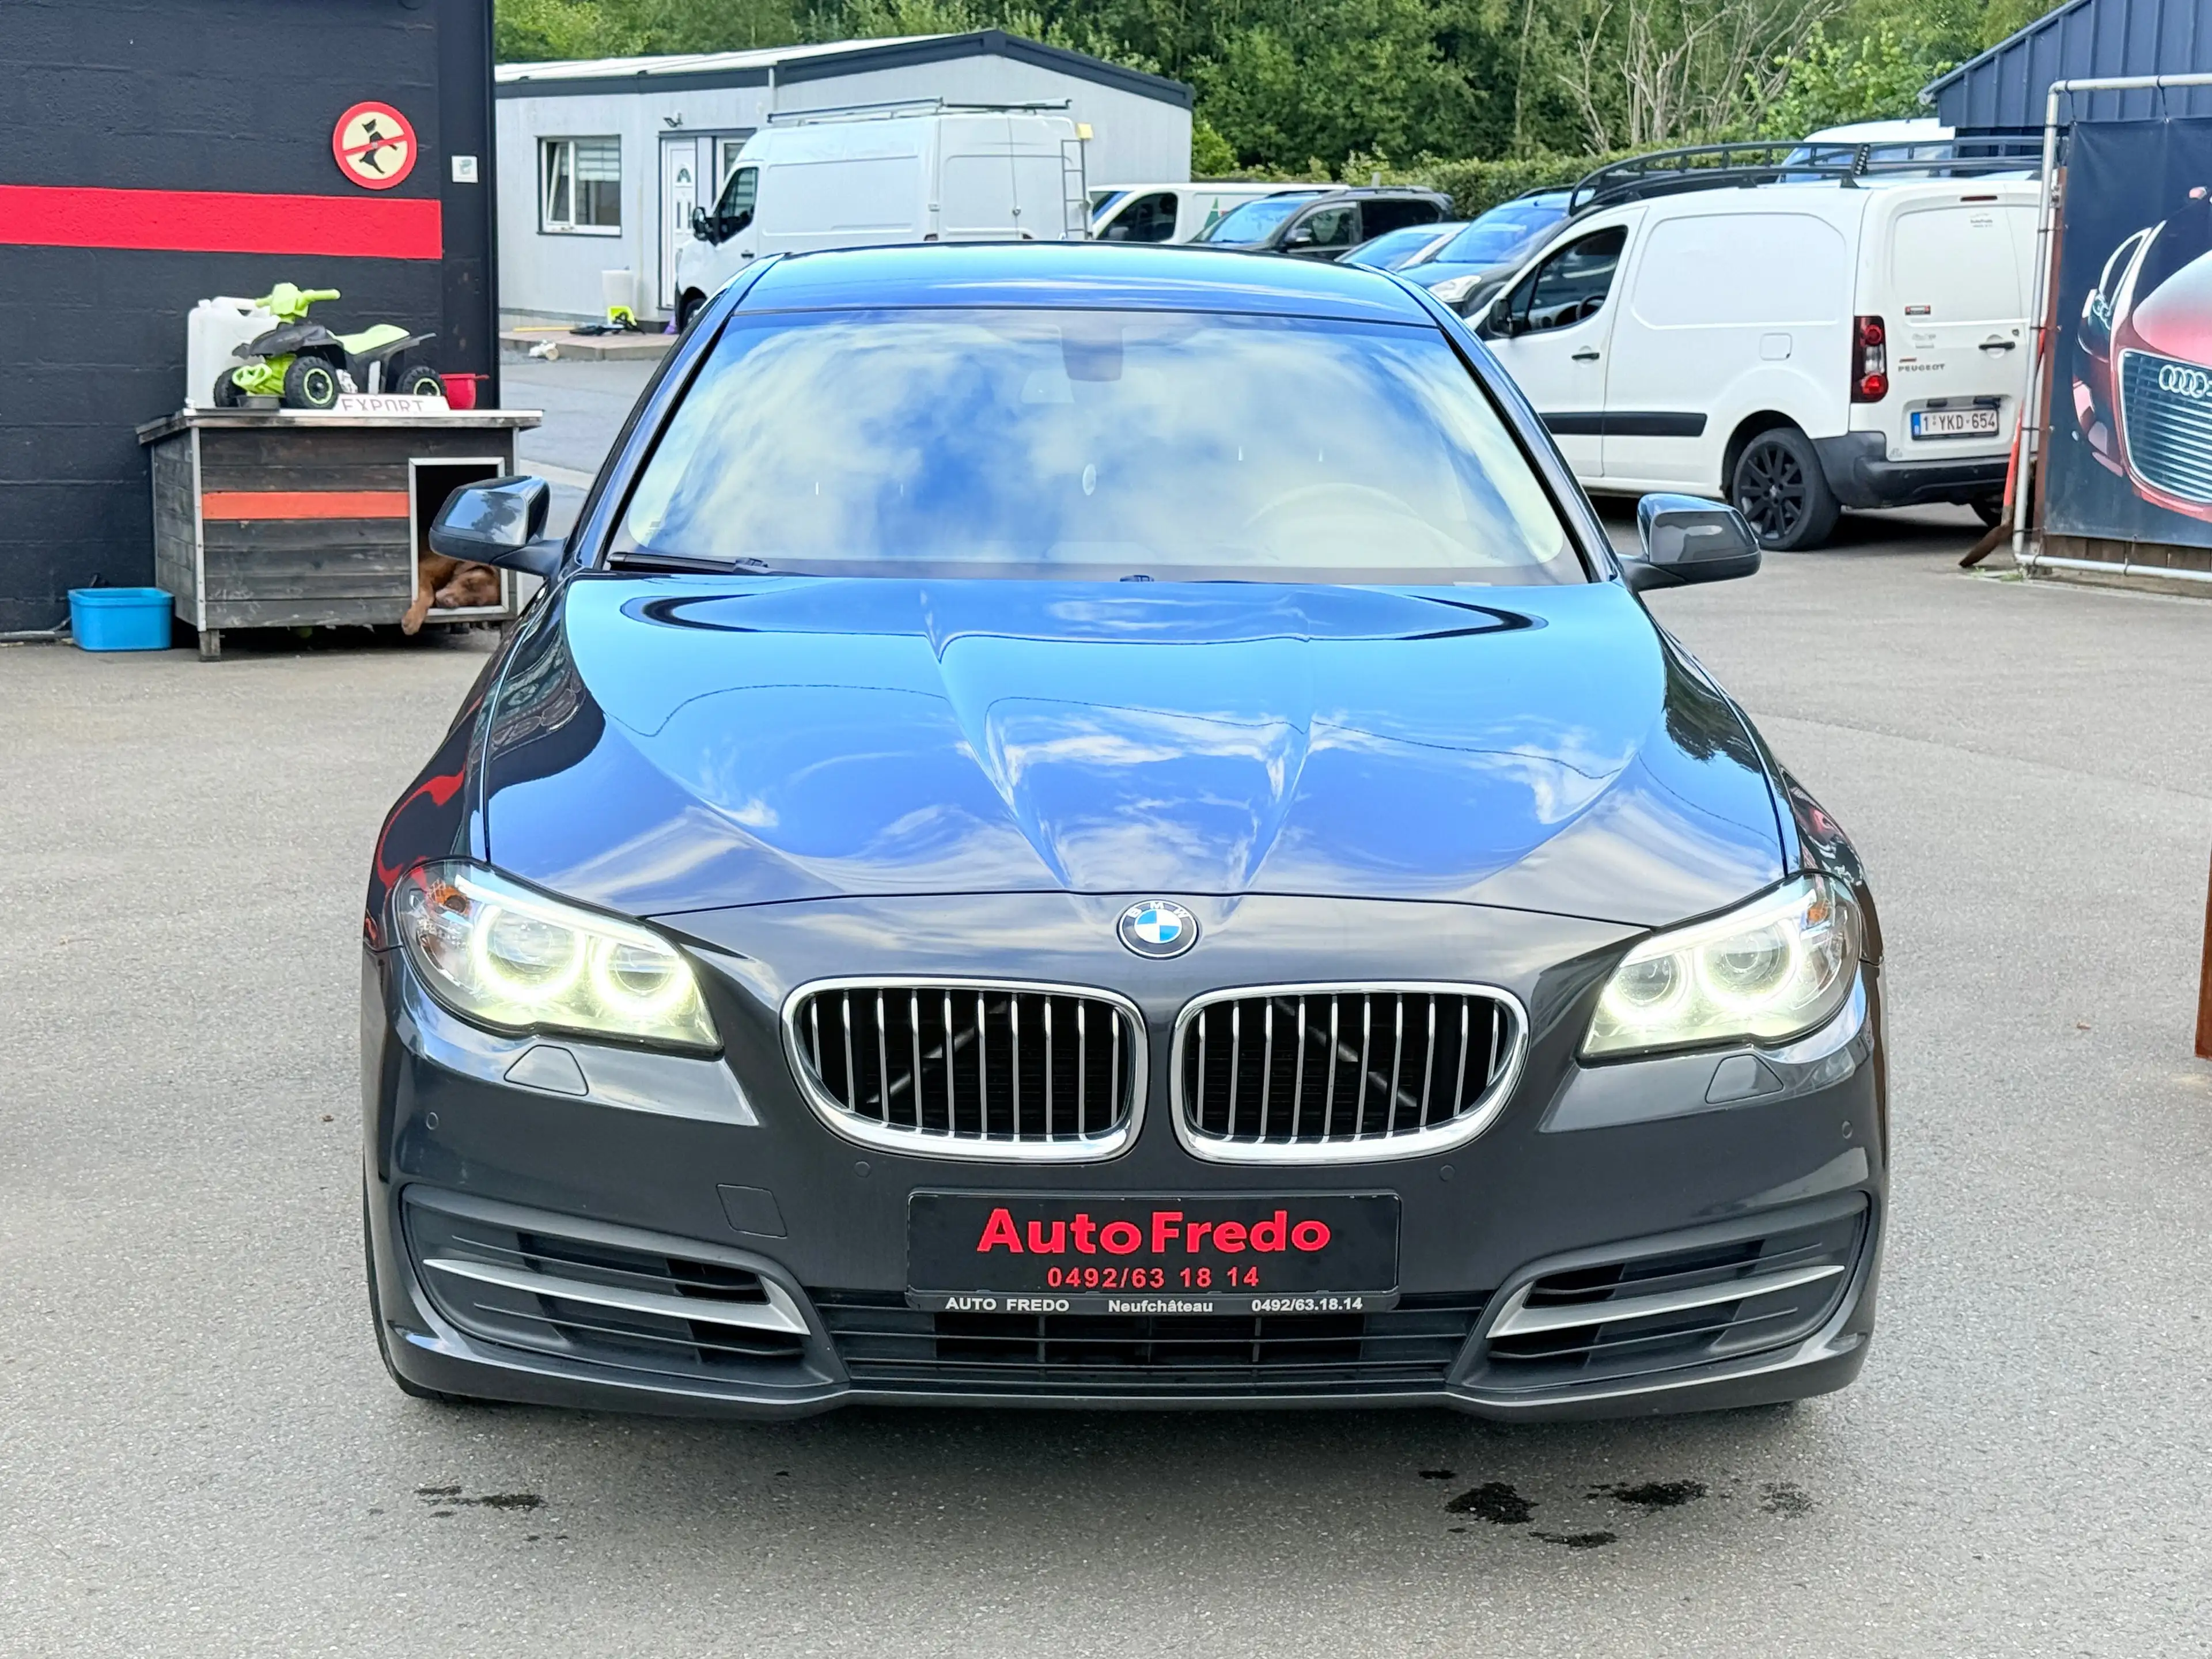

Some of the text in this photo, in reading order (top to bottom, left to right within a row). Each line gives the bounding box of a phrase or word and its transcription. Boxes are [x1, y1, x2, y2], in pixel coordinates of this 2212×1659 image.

[1897, 363, 1945, 372] PEUGEOT
[1126, 901, 1190, 918] BMW
[1047, 1266, 1259, 1289] 0492/63 18 14
[945, 1297, 1363, 1313] AUTO FREDO Neufchâteau 0492/63.18.14
